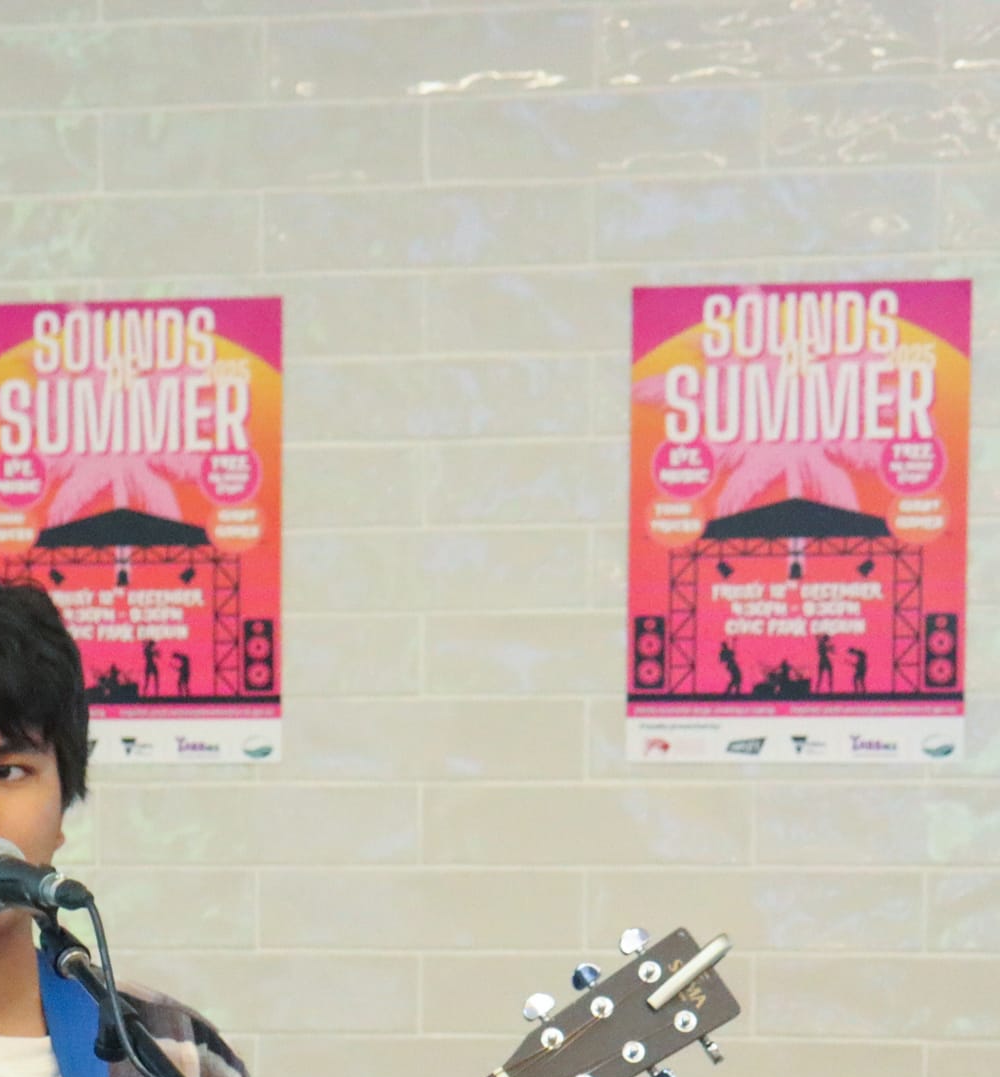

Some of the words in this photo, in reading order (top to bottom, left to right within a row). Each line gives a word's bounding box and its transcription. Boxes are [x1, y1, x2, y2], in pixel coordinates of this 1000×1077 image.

[34, 307, 216, 373] SOUNDS
[703, 289, 899, 358] SOUNDS
[0, 377, 250, 457] SUMMER
[665, 360, 934, 443] SUMMER
